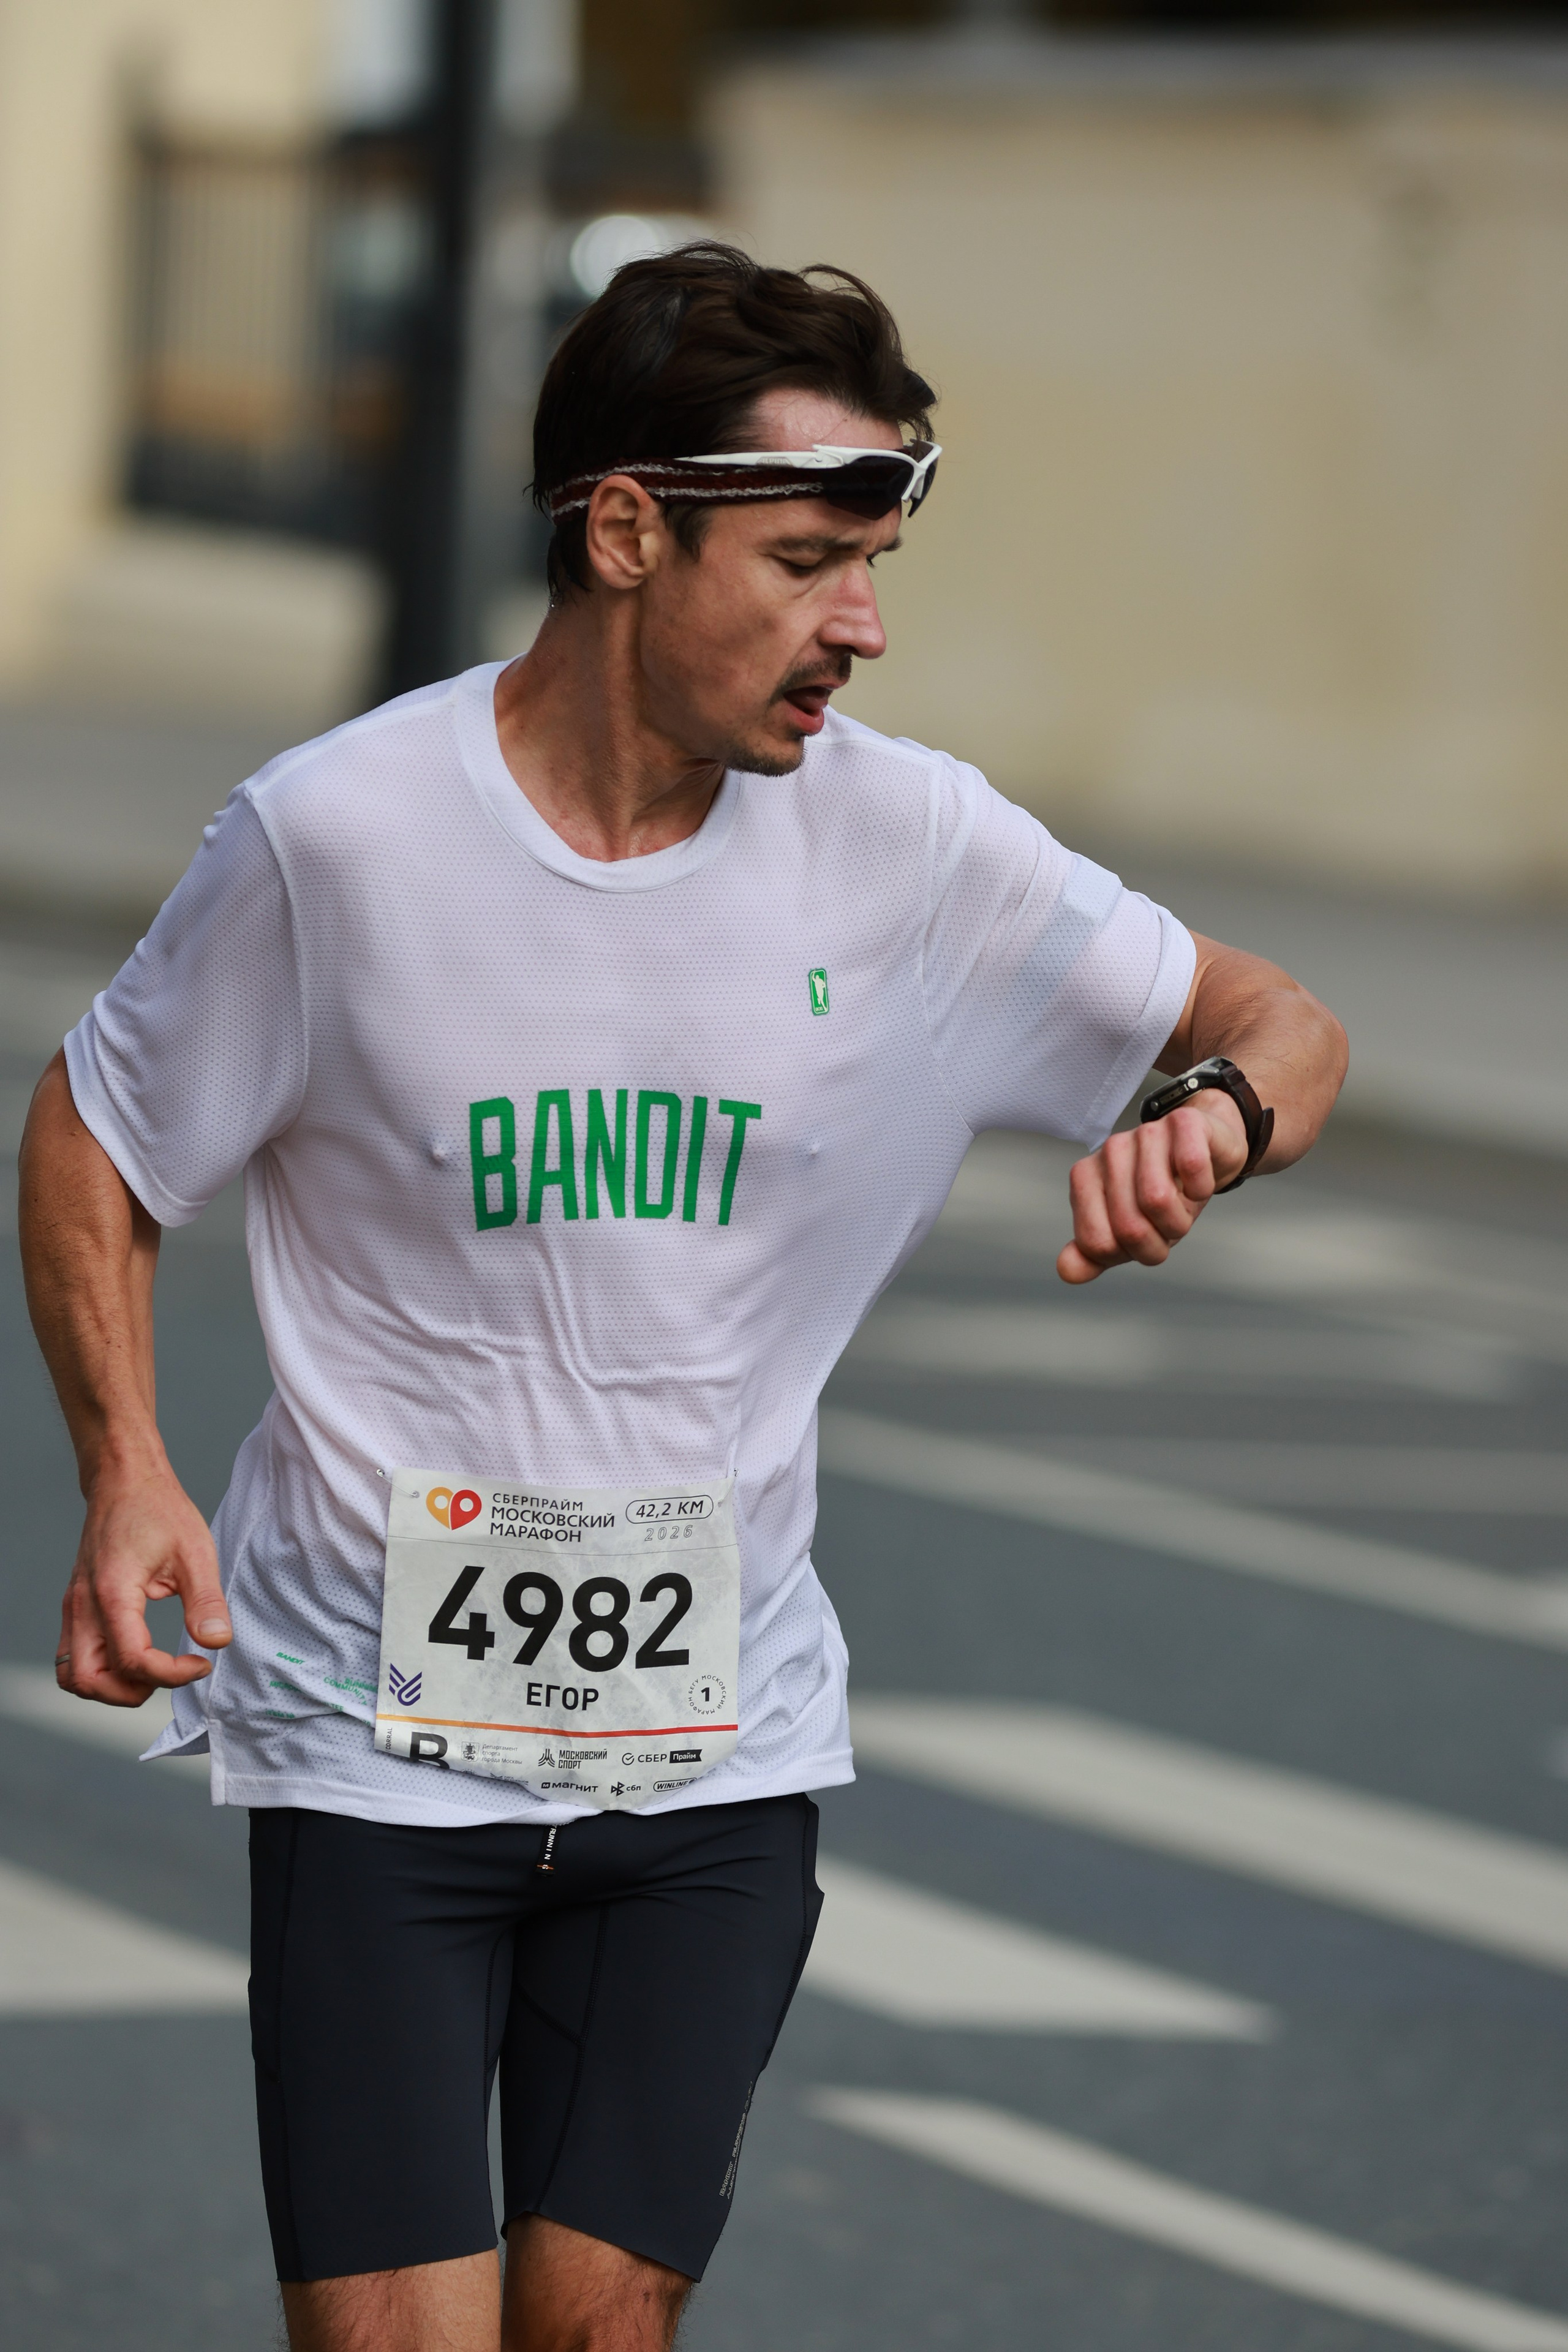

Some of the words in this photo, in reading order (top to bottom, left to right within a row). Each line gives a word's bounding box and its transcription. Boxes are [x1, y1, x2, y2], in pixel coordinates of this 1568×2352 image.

[469, 1089, 761, 1231] BANDIT
[492, 1493, 583, 1511] СБЕРПРАЙМ
[636, 1502, 671, 1518] 42,2
[491, 1506, 615, 1528] МОСКОВСКИЙ
[490, 1522, 581, 1542] МАРАФОН
[644, 1525, 693, 1541] 2026
[428, 1566, 693, 1672] 4982
[276, 1652, 305, 1665] BANDIT
[688, 1679, 698, 1694] БЕГУ
[701, 1675, 726, 1709] МОСКОВСКИЙ
[701, 1687, 710, 1702] 1
[527, 1682, 599, 1710] ЕГОР
[688, 1697, 715, 1714] МАРАФОН
[559, 1749, 608, 1760] МОСКОВСКИЙ
[638, 1754, 667, 1763] СБЕР
[673, 1752, 696, 1761] Прайм
[558, 1760, 582, 1769] СПОРТ
[552, 1782, 598, 1792] магнит
[657, 1780, 689, 1789] WINLINE
[719, 2161, 733, 2196] BANDIT
